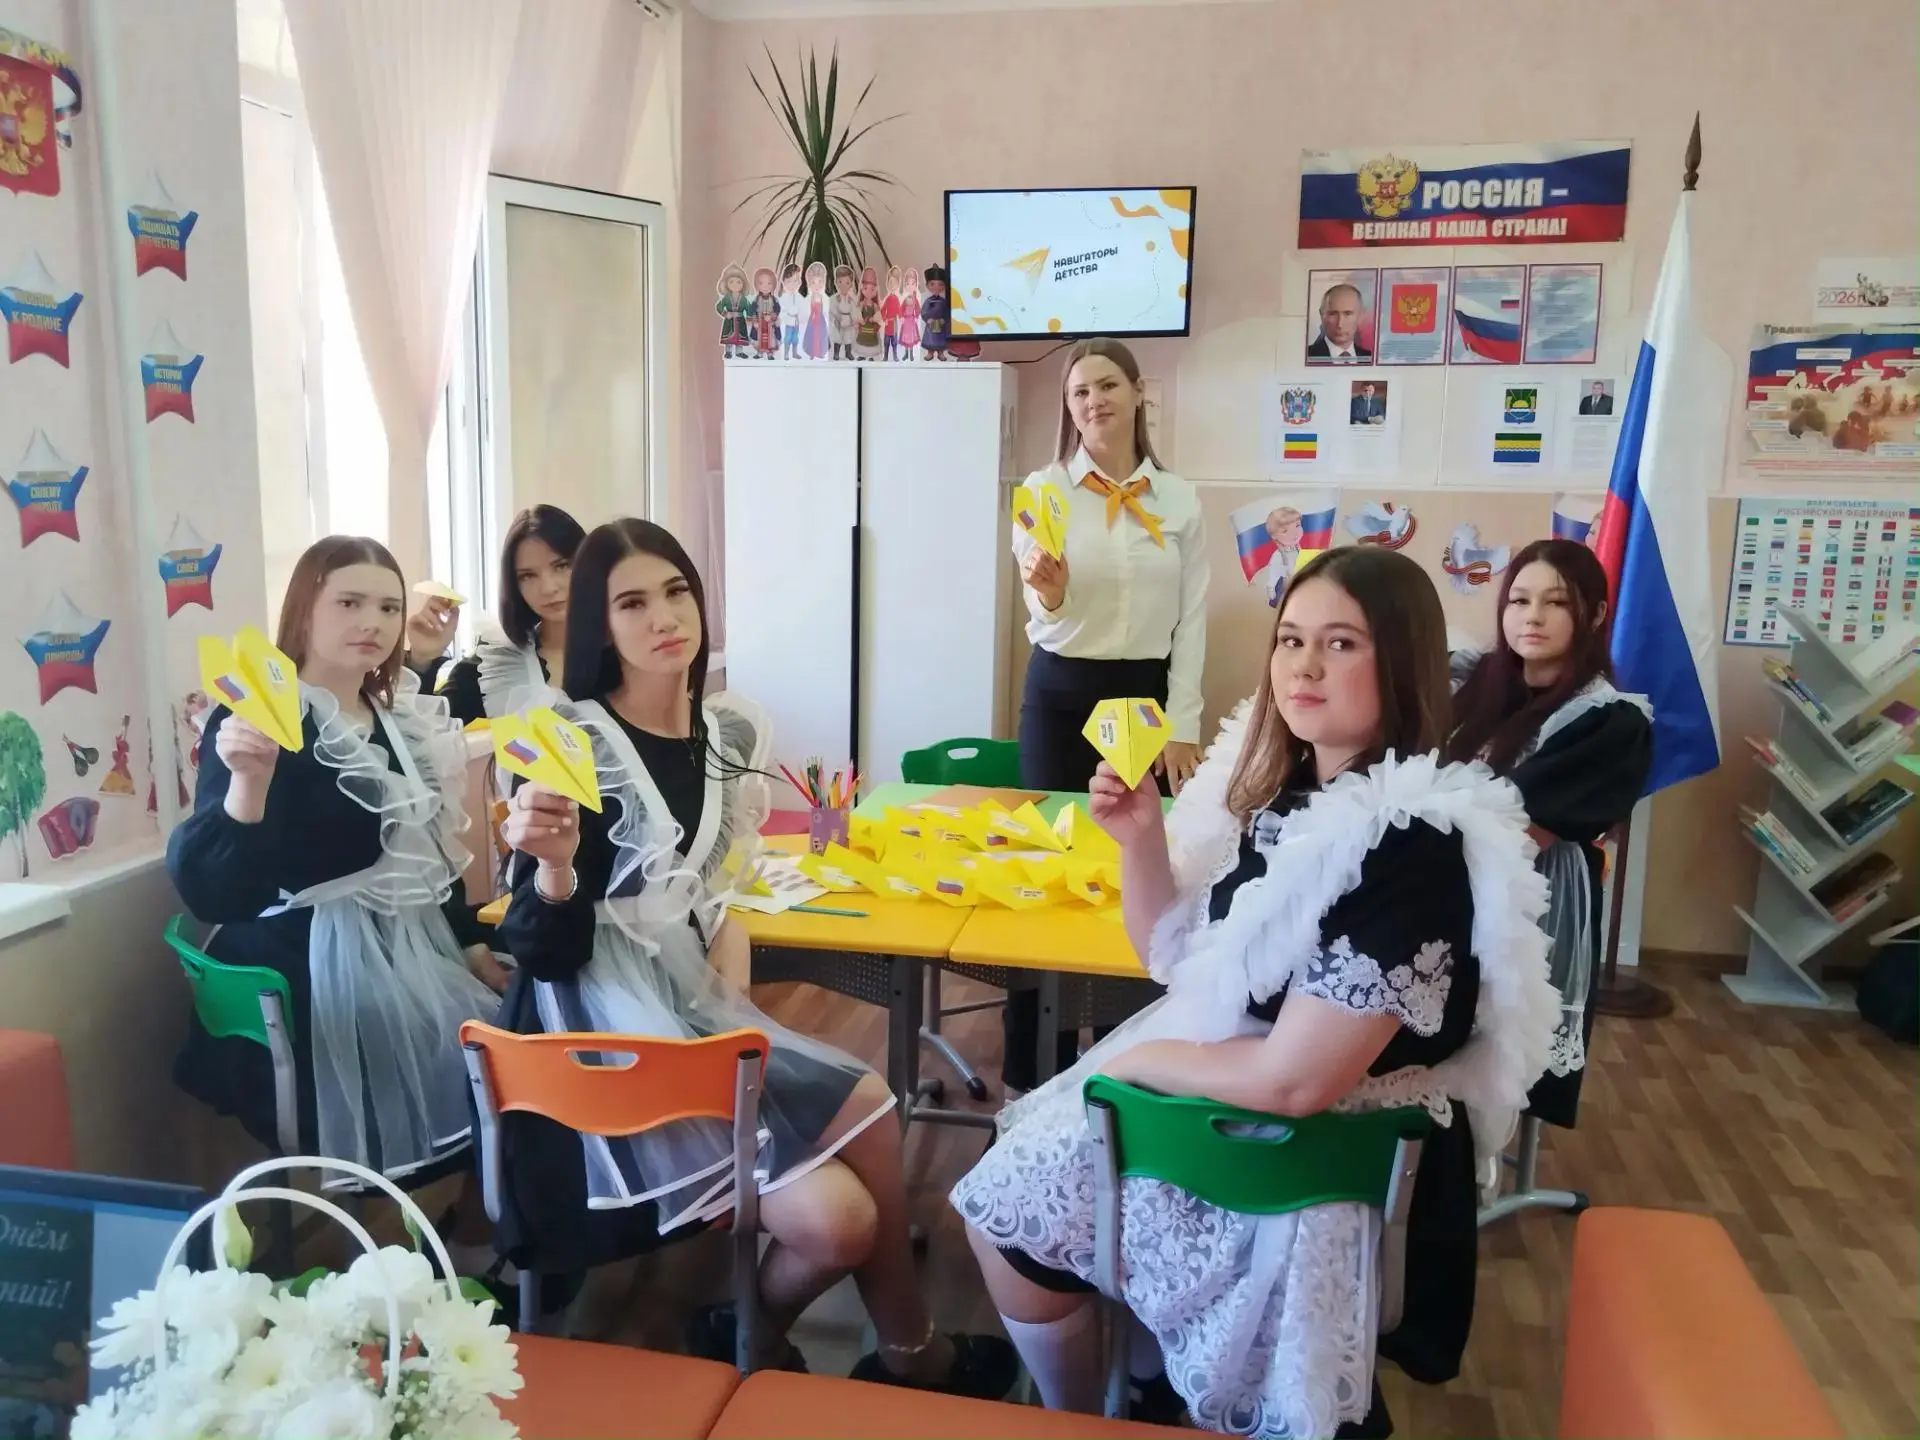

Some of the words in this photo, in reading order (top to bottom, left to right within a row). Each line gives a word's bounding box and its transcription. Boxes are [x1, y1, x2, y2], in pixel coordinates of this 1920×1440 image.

[1422, 178, 1544, 209] РОССИЯ
[1352, 220, 1432, 240] ВЕЛИКАЯ
[1435, 219, 1487, 238] НАША
[1491, 217, 1568, 237] СТРАНА!
[1053, 246, 1119, 269] НАВИГАТОРЫ
[1054, 263, 1098, 282] ДЕТСТВА
[1817, 290, 1857, 305] 2026
[22, 313, 63, 333] РОДИНЕ
[1777, 507, 1842, 517] РОССИЙСКОЙ
[1846, 509, 1906, 519] ФЕДЕРАЦИИ
